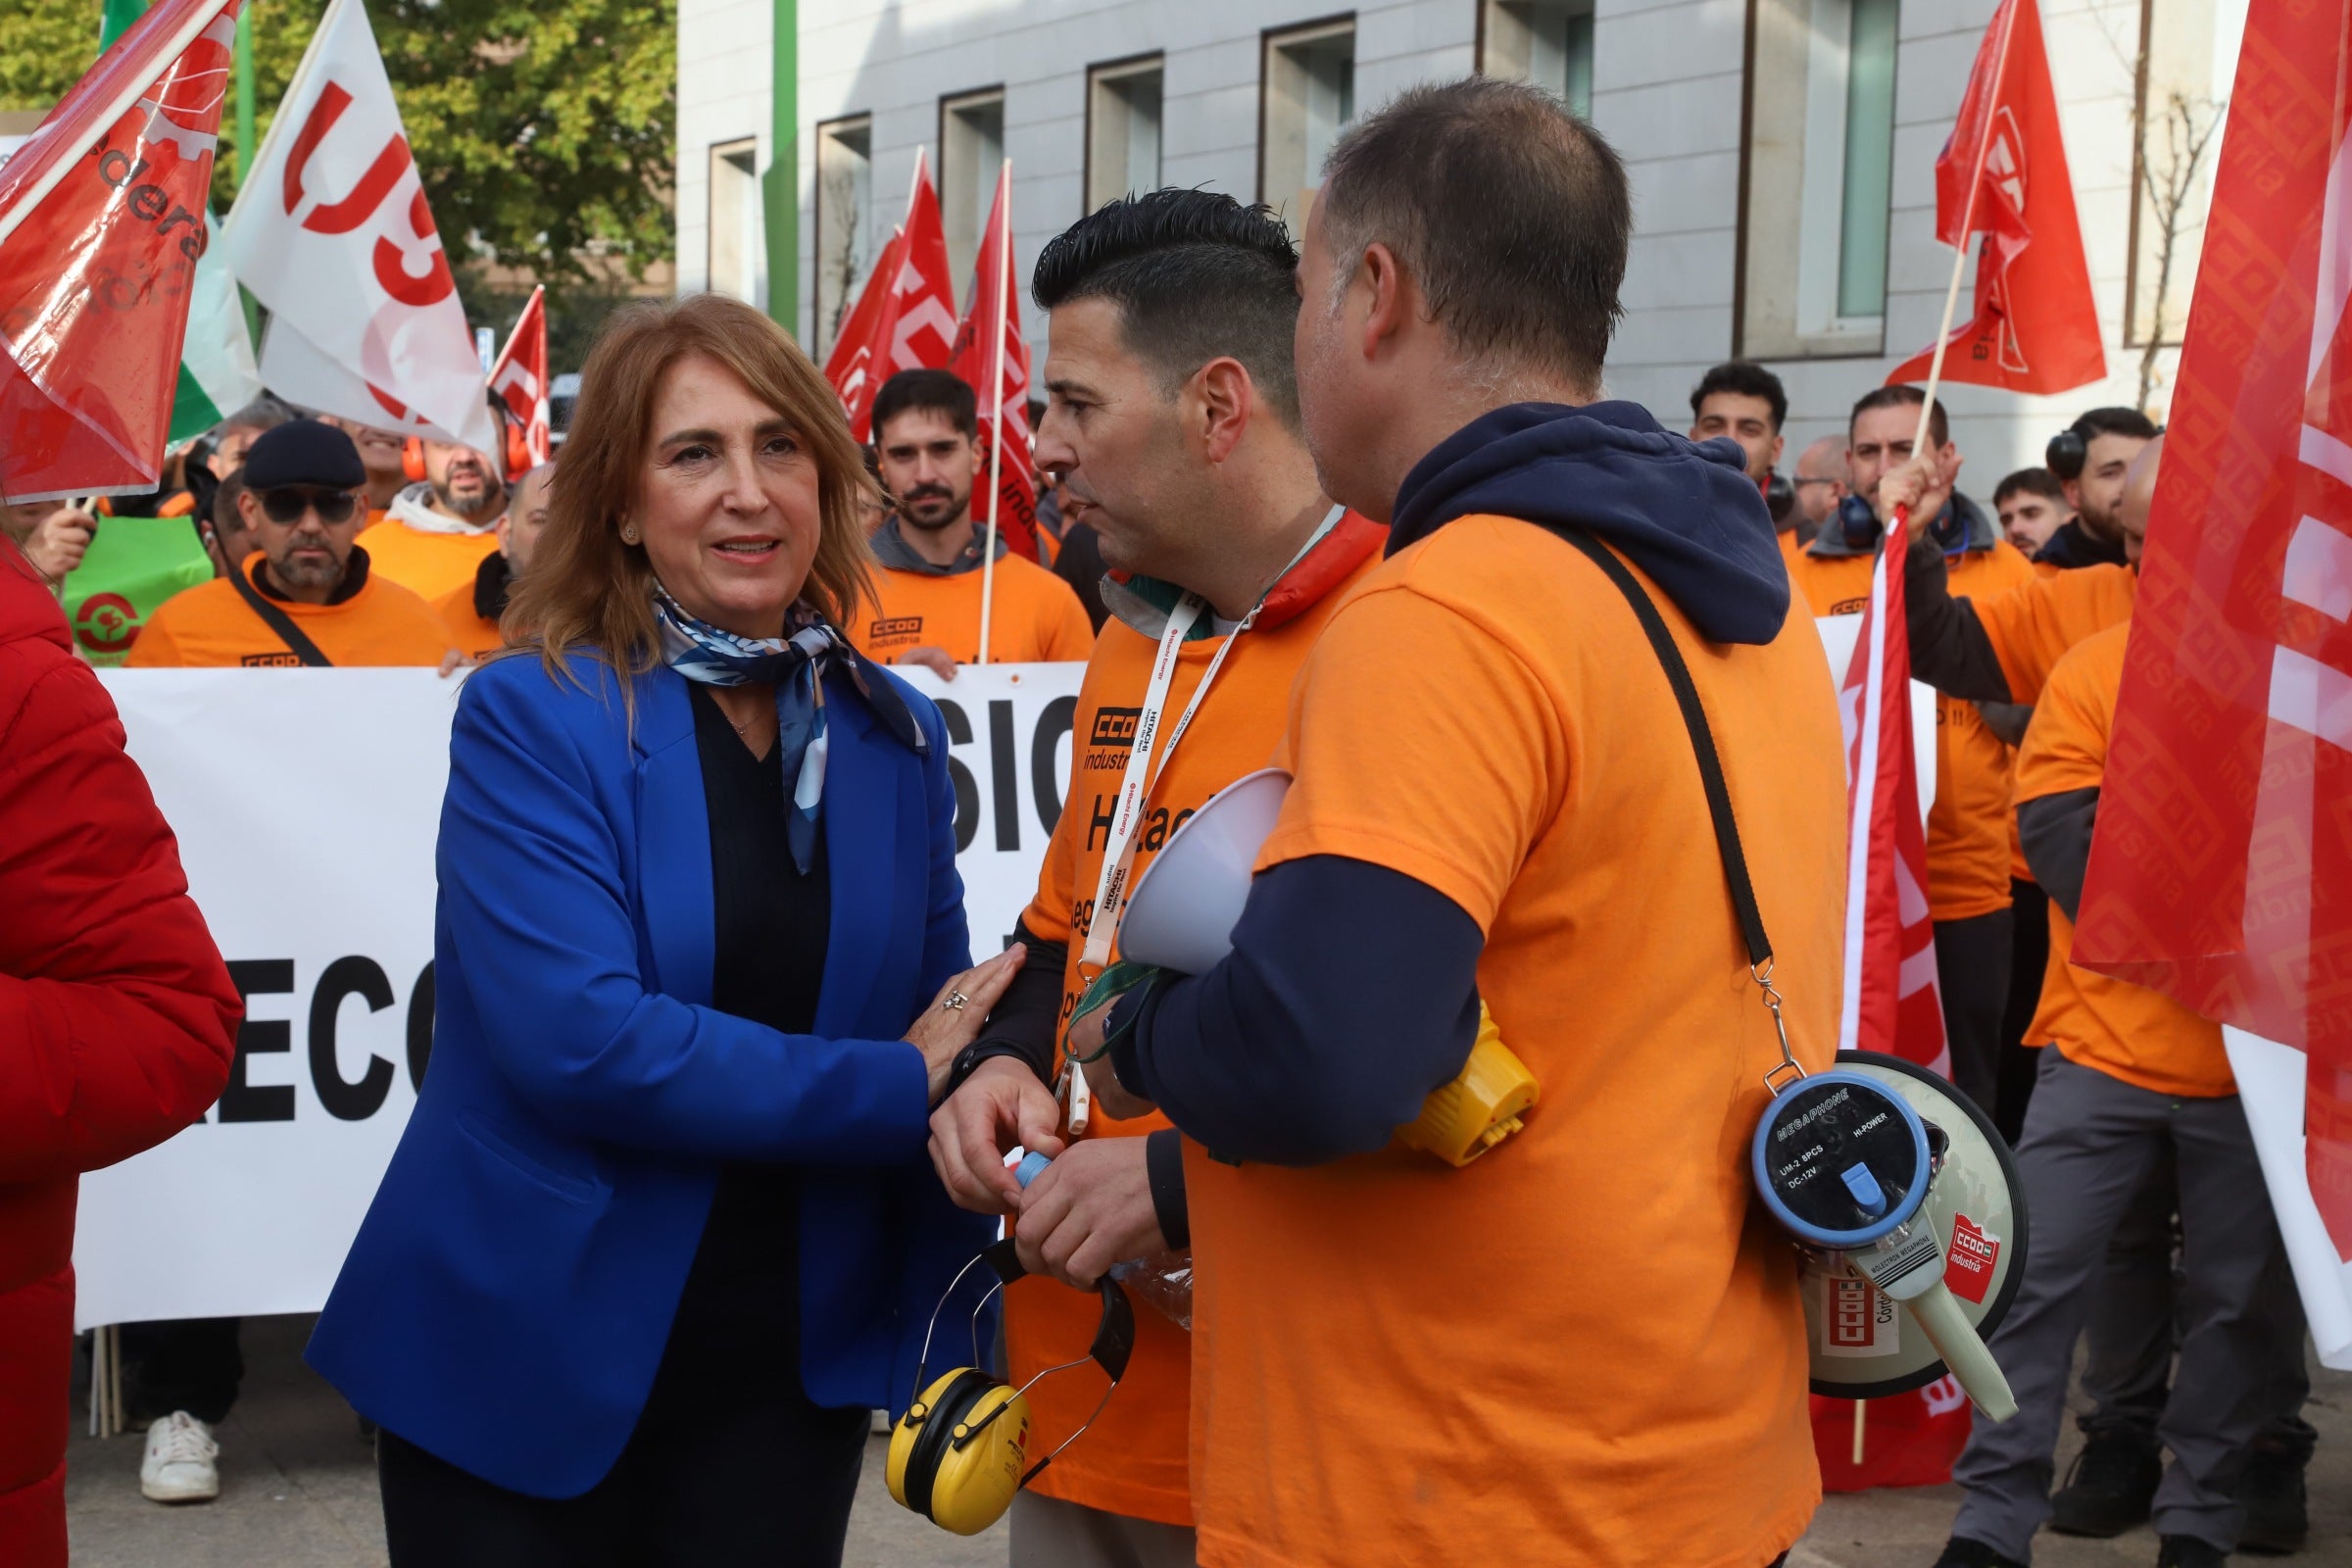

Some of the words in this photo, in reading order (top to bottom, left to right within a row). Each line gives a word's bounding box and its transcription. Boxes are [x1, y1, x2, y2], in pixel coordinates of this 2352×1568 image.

[873, 619, 919, 635] CCOO
[868, 636, 920, 650] industria
[1157, 658, 1169, 680] Energy
[1142, 711, 1156, 753] HITACHI
[1124, 790, 1136, 812] Hitachi
[1118, 812, 1130, 836] Energy
[1104, 869, 1122, 909] HITACHI
[193, 955, 435, 1124] EC
[1777, 1087, 1850, 1143] MEGAPHONE
[1852, 1112, 1888, 1138] HI-POWER
[1780, 1159, 1801, 1176] UM-2
[1801, 1145, 1824, 1163] 8PCS
[1788, 1166, 1818, 1190] DC-12V
[1871, 1250, 1901, 1274] MOLECTRON
[1900, 1235, 1931, 1256] MEGAPHONE
[1956, 1233, 1984, 1254] CCOO
[1950, 1250, 1983, 1274] industria
[1838, 1290, 1865, 1342] CCOO
[1877, 1293, 1891, 1324] Córdo
